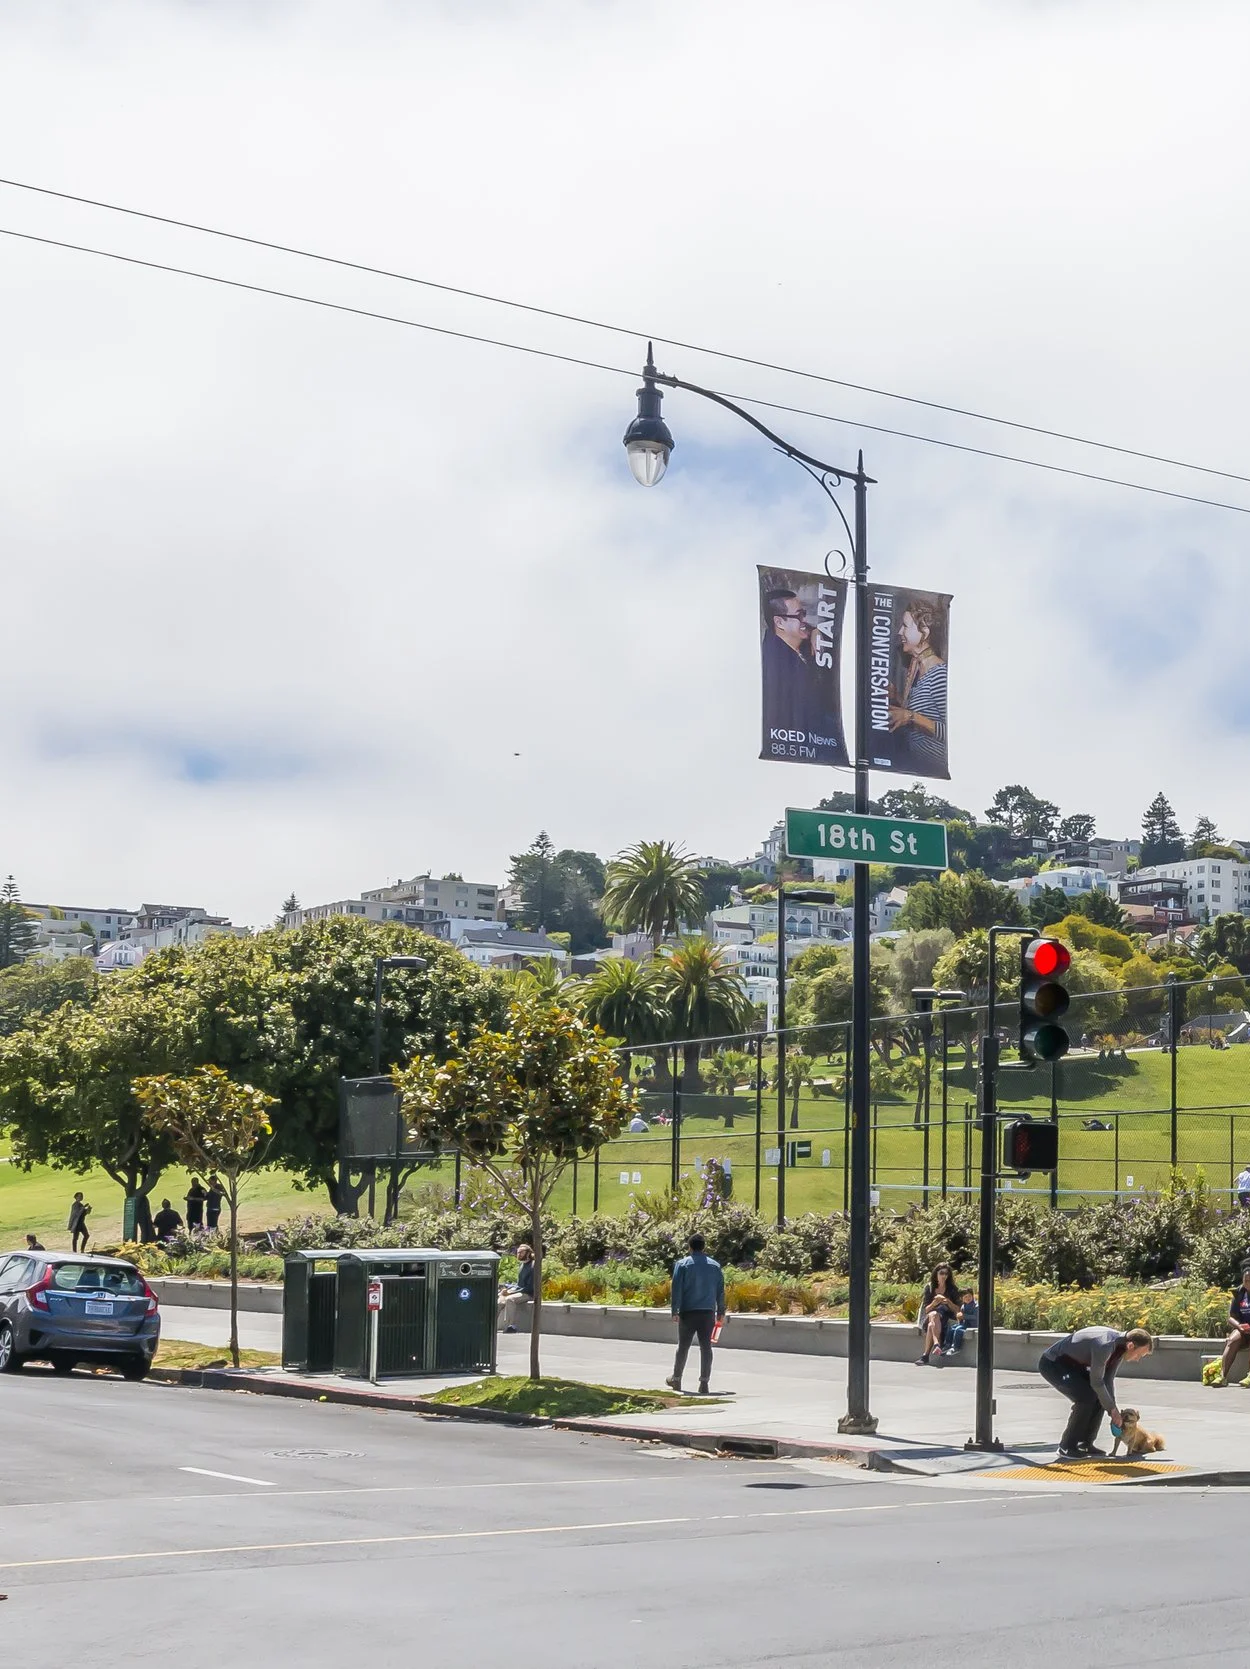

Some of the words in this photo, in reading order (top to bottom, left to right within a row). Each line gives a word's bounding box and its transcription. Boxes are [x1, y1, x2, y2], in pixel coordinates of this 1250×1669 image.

[874, 596, 893, 608] THE
[815, 583, 838, 669] START
[871, 616, 892, 732] CONVERSATION
[770, 728, 806, 743] KQED
[808, 733, 838, 748] News
[771, 743, 797, 757] 88.5
[799, 745, 816, 758] FM
[817, 823, 876, 852] 18th
[889, 830, 918, 856] St
